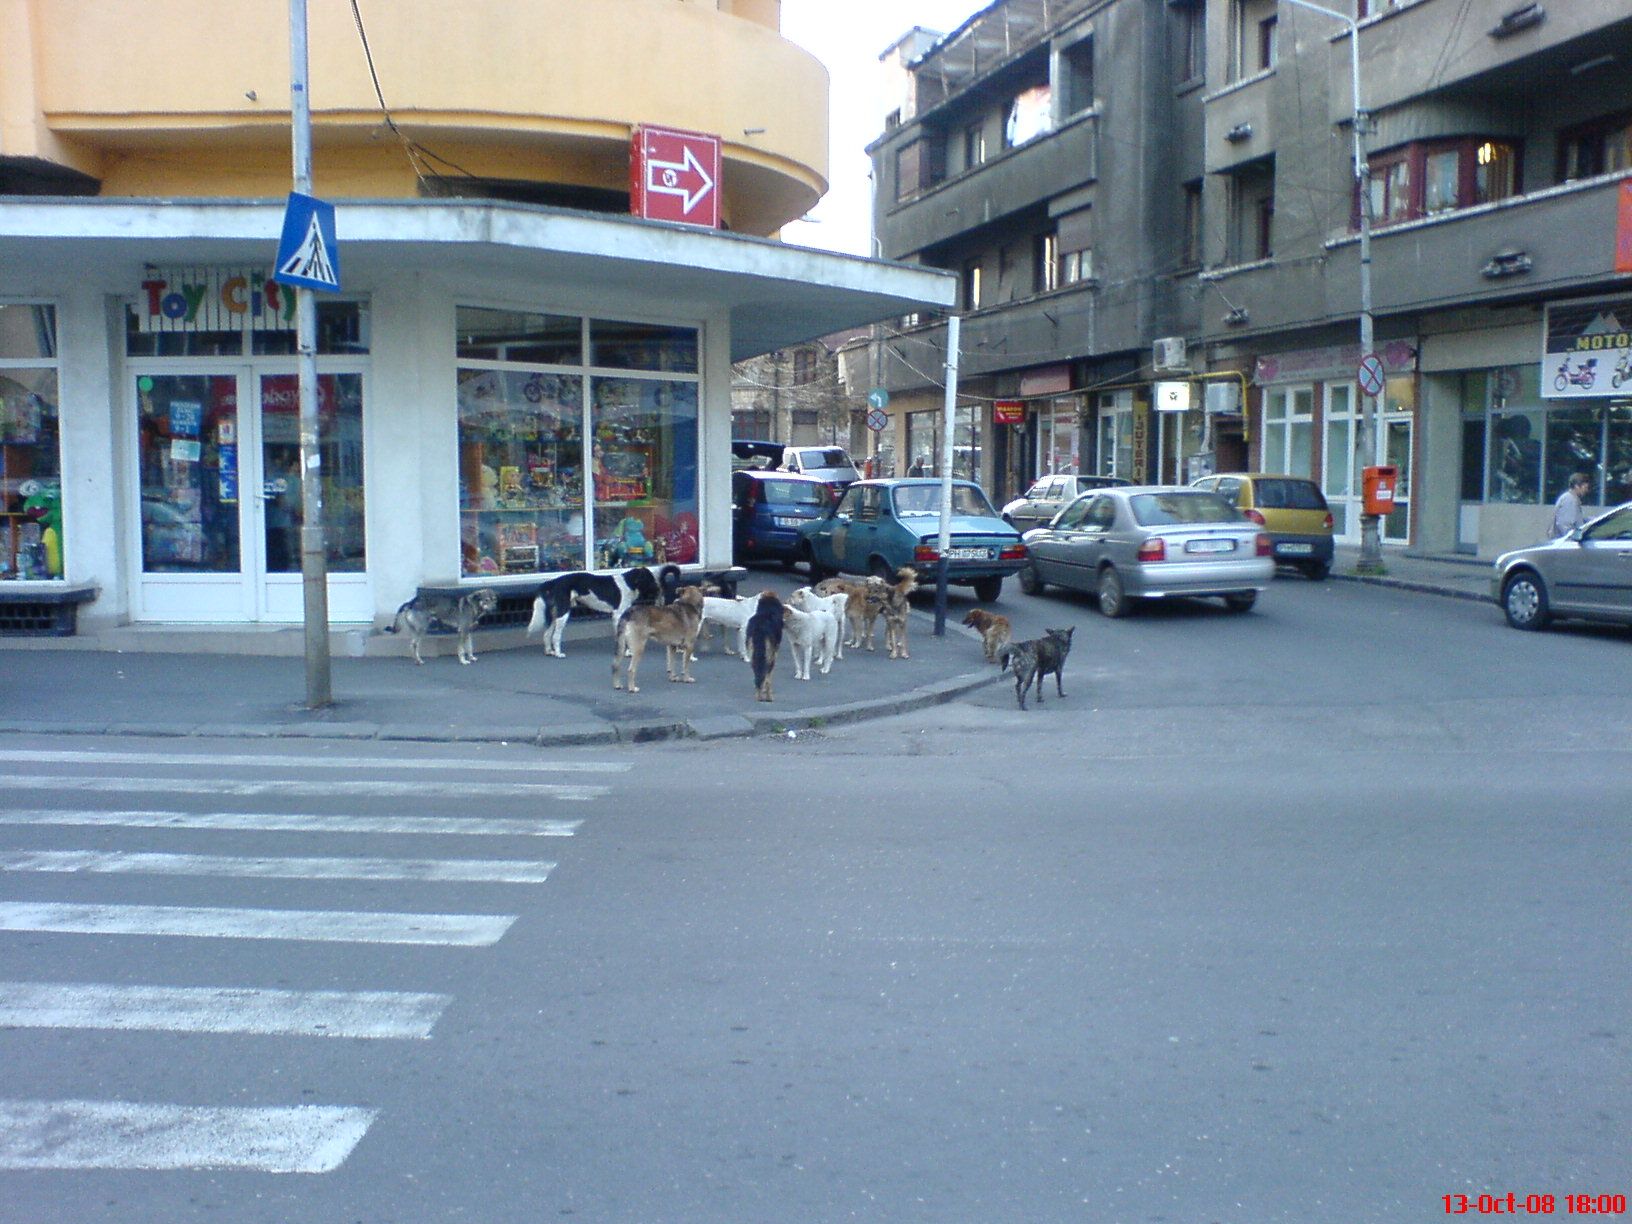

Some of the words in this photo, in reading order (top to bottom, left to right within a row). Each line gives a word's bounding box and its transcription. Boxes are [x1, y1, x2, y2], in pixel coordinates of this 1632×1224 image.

[142, 280, 207, 322] Toy
[221, 271, 297, 321] City
[1576, 333, 1632, 350] MOTO
